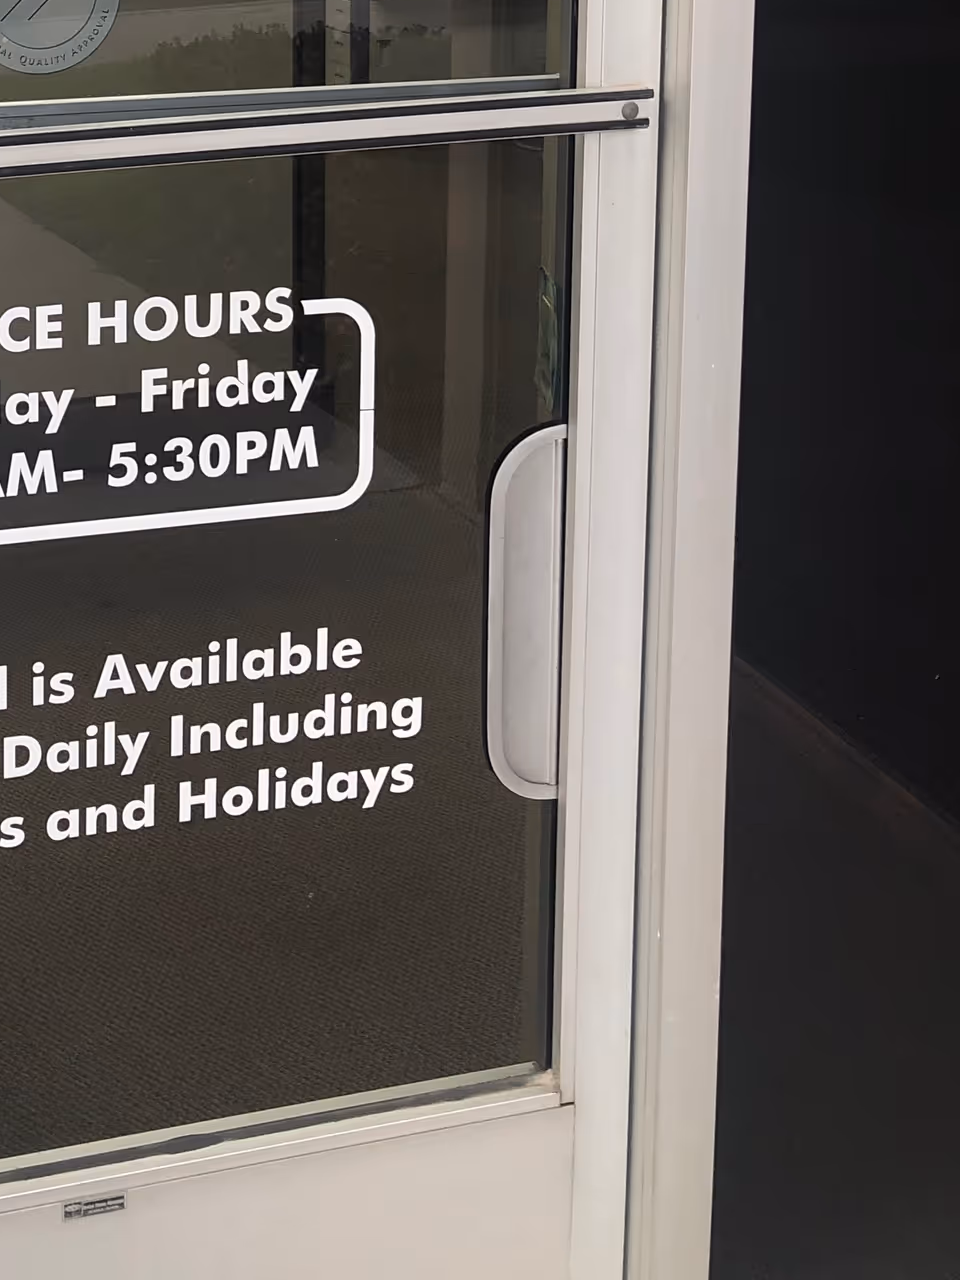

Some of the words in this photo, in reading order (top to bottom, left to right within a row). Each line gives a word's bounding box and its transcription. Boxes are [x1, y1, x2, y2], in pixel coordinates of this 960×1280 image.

[87, 287, 294, 346] HOURS
[95, 395, 116, 408] -
[141, 360, 319, 413] Friday
[107, 426, 320, 488] 5:30PM
[32, 661, 75, 706] is
[94, 627, 363, 699] Available
[3, 721, 150, 779] Daily
[170, 693, 423, 757] Including
[46, 784, 155, 841] and
[178, 762, 414, 823] Holidays
